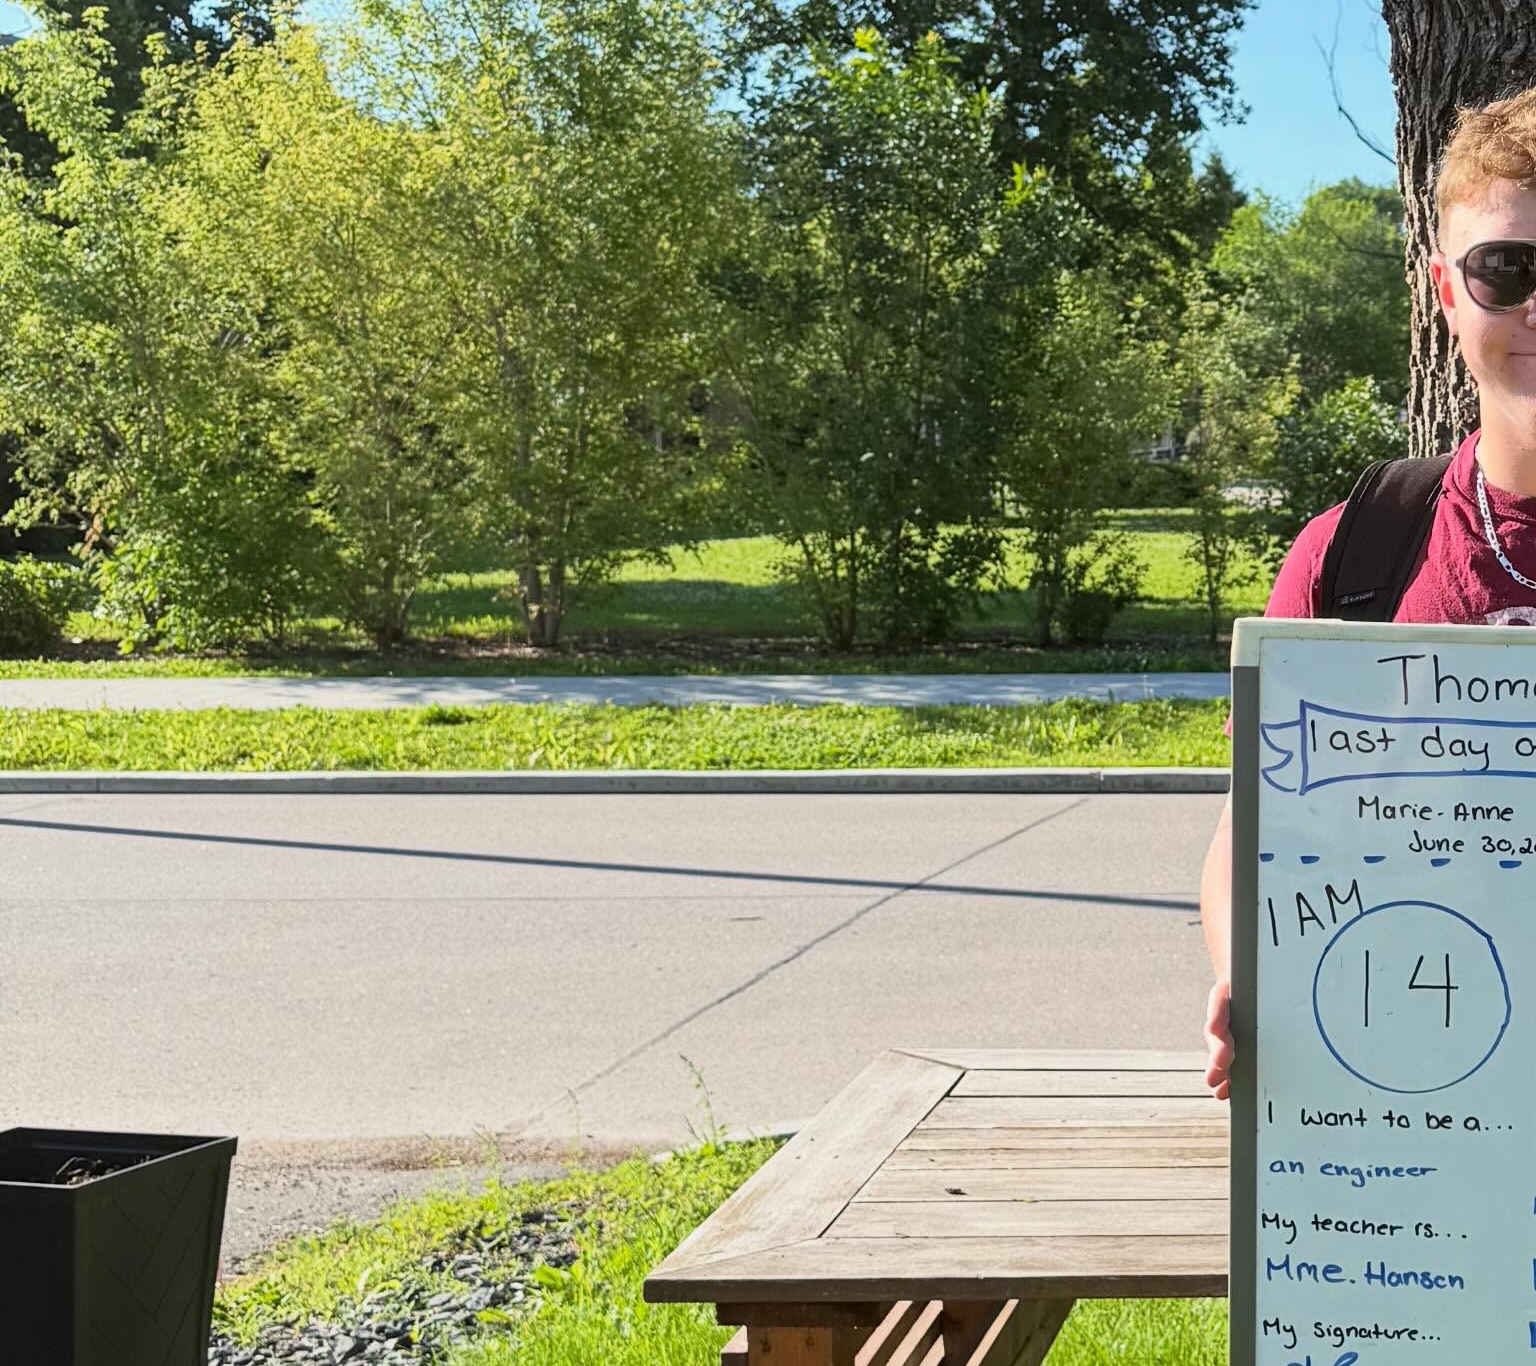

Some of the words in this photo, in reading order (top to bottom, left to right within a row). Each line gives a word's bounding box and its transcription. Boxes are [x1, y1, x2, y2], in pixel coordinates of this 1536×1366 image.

[1311, 720, 1396, 753] last
[1421, 726, 1489, 772] day
[1409, 830, 1465, 852] June
[1296, 879, 1363, 936] AM
[1364, 950, 1458, 1027] 14
[1301, 1108, 1367, 1127] want
[1383, 1110, 1410, 1128] to
[1426, 1112, 1452, 1129] be
[1463, 1116, 1513, 1131] a...
[1269, 1160, 1305, 1174] an
[1320, 1162, 1438, 1188] engineer
[1262, 1212, 1297, 1244] My
[1311, 1214, 1403, 1236] teacher
[1266, 1253, 1356, 1284] Mme.
[1262, 1317, 1297, 1349] My
